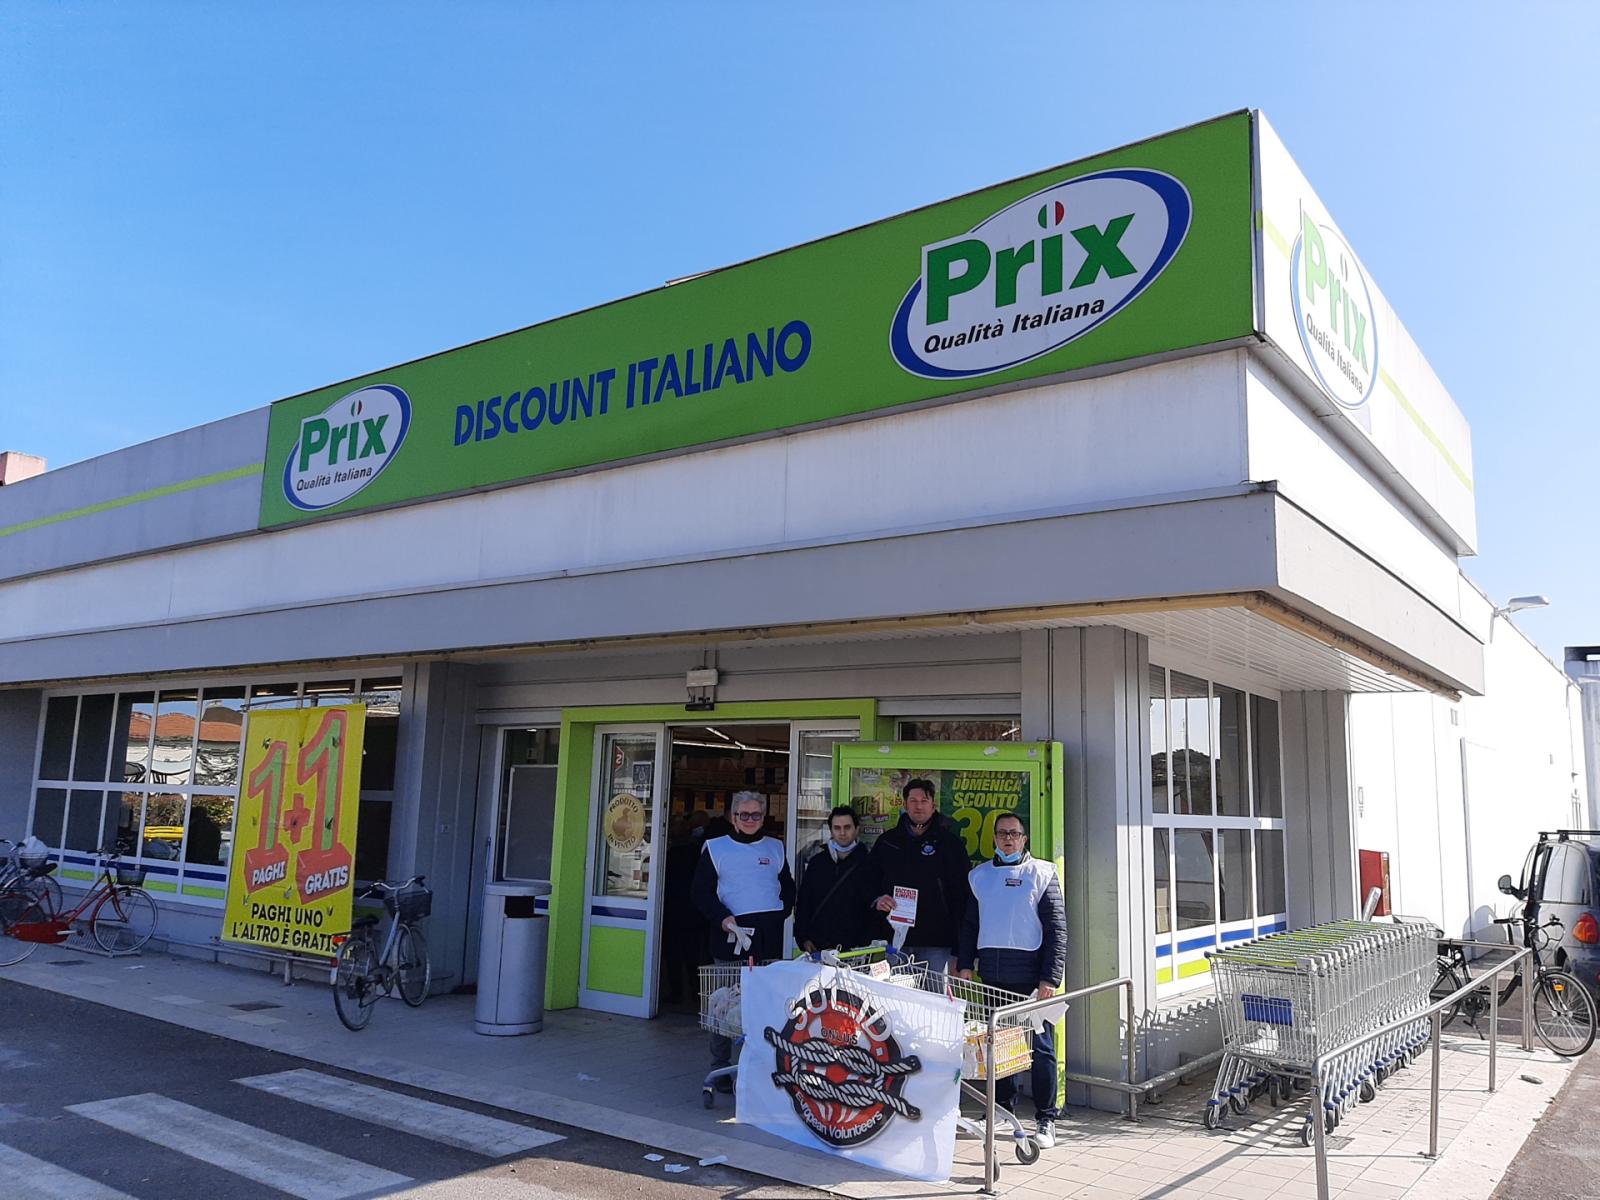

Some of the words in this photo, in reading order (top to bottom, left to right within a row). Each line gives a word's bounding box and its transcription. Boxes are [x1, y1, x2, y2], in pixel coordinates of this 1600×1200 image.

[925, 200, 1138, 325] Prix
[1303, 210, 1369, 376] Prix
[924, 319, 1004, 353] Qualità
[1011, 299, 1105, 333] Italiana
[1306, 313, 1335, 360] Qualità
[1336, 349, 1363, 395] Italiana
[454, 368, 616, 446] DISCOUNT
[626, 320, 812, 408] ITALIANO
[299, 400, 389, 472] Prix
[296, 473, 331, 491] Qualità
[334, 466, 373, 484] Italiana
[952, 778, 1021, 791] DOMENICA
[609, 797, 639, 813] PRODOTTO
[953, 792, 1019, 809] SCONTO
[252, 861, 286, 887] PAGHI
[304, 865, 349, 895] GRATIS
[251, 902, 292, 923] PAGHI
[295, 908, 323, 928] UNO
[232, 921, 280, 943] L'ALTRO
[821, 1027, 859, 1045] ONLUS
[795, 1091, 827, 1135] European
[829, 1111, 883, 1140] Volunteers
